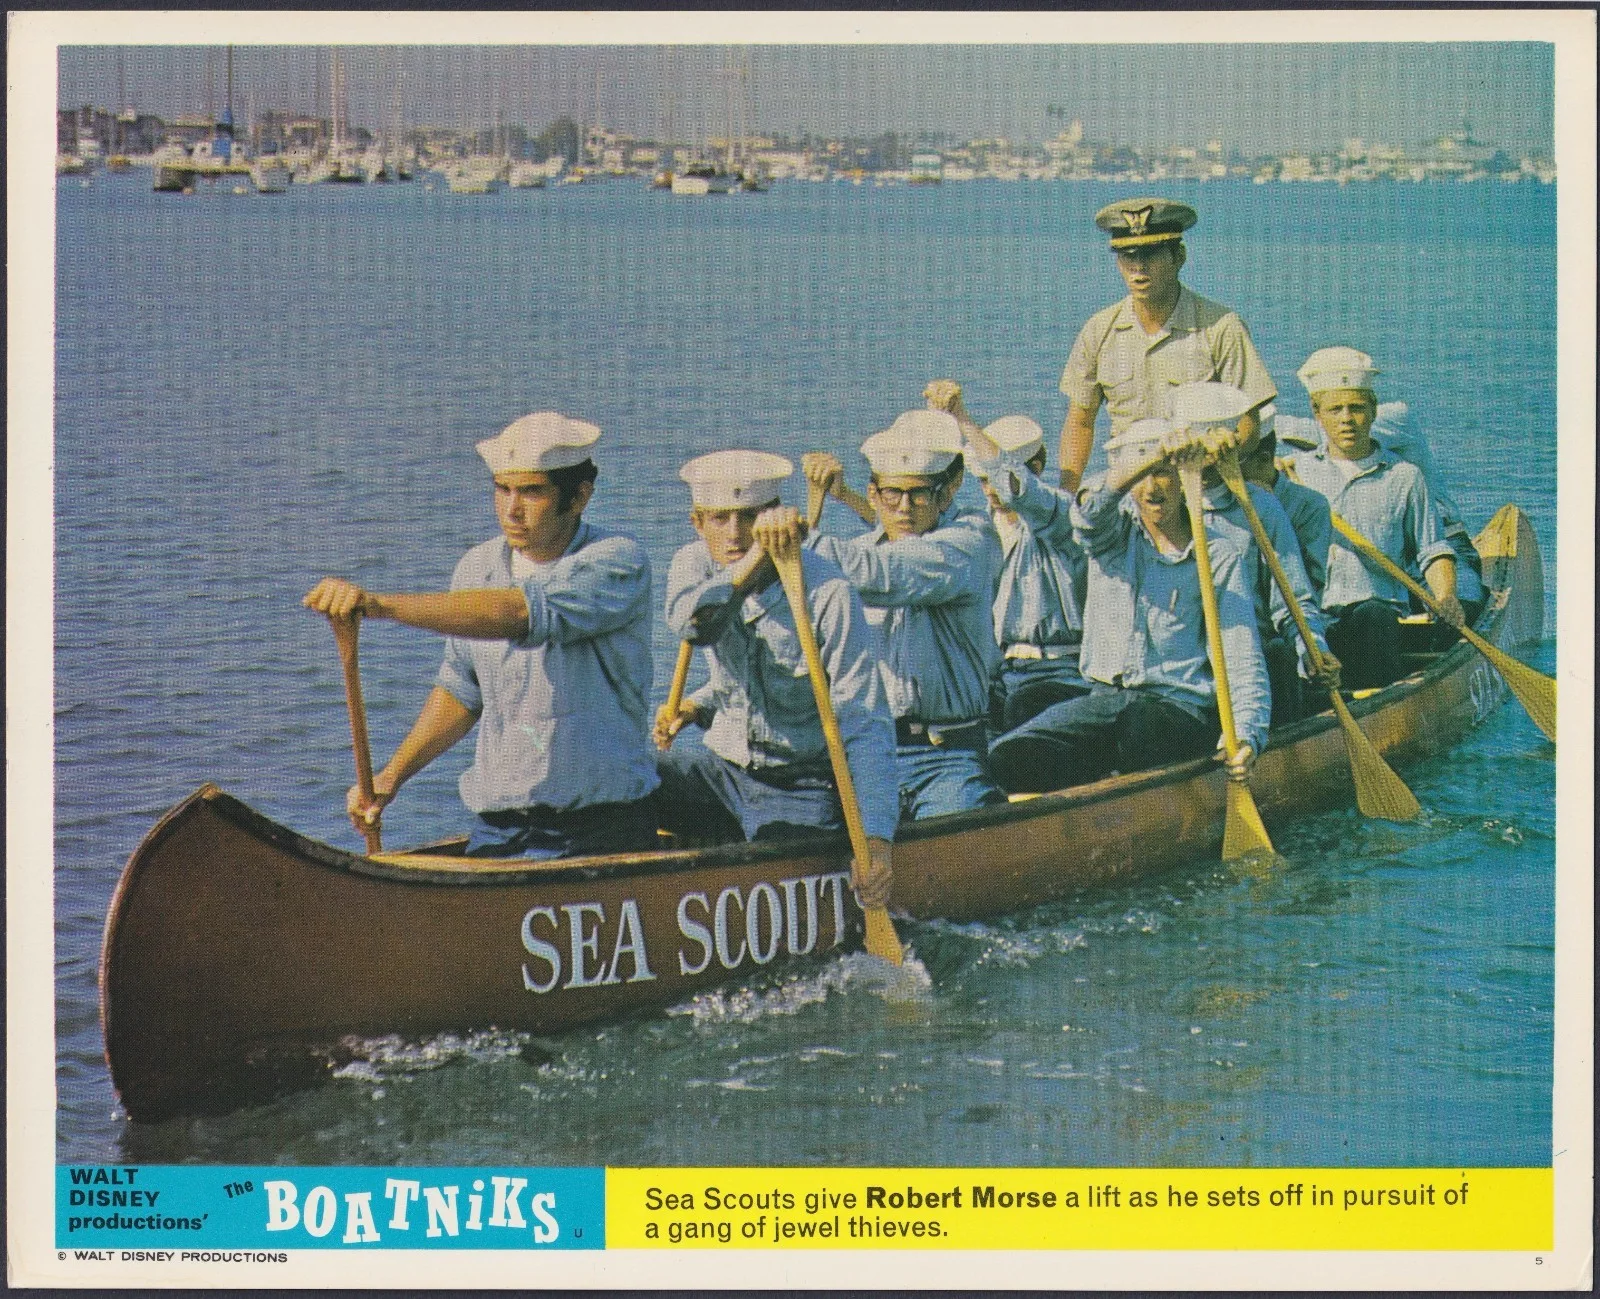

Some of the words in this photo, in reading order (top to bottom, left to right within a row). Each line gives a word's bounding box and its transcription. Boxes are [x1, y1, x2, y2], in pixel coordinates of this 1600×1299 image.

[520, 898, 657, 995] SEA
[676, 870, 866, 976] SCOUT
[69, 1167, 139, 1186] WALT
[69, 1188, 160, 1208] DISNEY
[222, 1178, 255, 1200] The
[645, 1187, 695, 1211] Sea
[703, 1186, 796, 1211] Scouts
[804, 1187, 857, 1215] give
[866, 1186, 962, 1209] Robert
[972, 1185, 1057, 1209] Morse
[1065, 1191, 1080, 1208] a
[1088, 1184, 1121, 1208] lift
[1129, 1190, 1158, 1208] as
[1168, 1184, 1199, 1207] he
[1207, 1185, 1260, 1207] sets
[1269, 1183, 1304, 1207] off
[1312, 1184, 1334, 1206] in
[1344, 1183, 1436, 1211] pursuit
[1443, 1182, 1469, 1206] of
[645, 1222, 660, 1239] a
[668, 1222, 731, 1244] gang
[741, 1215, 767, 1239] of
[773, 1215, 839, 1243] jewel
[847, 1215, 948, 1238] thieves.
[74, 1250, 116, 1261] WALT
[121, 1250, 175, 1262] DISNEY
[181, 1250, 288, 1263] PRODUCTIONS
[1534, 1255, 1544, 1267] 5
